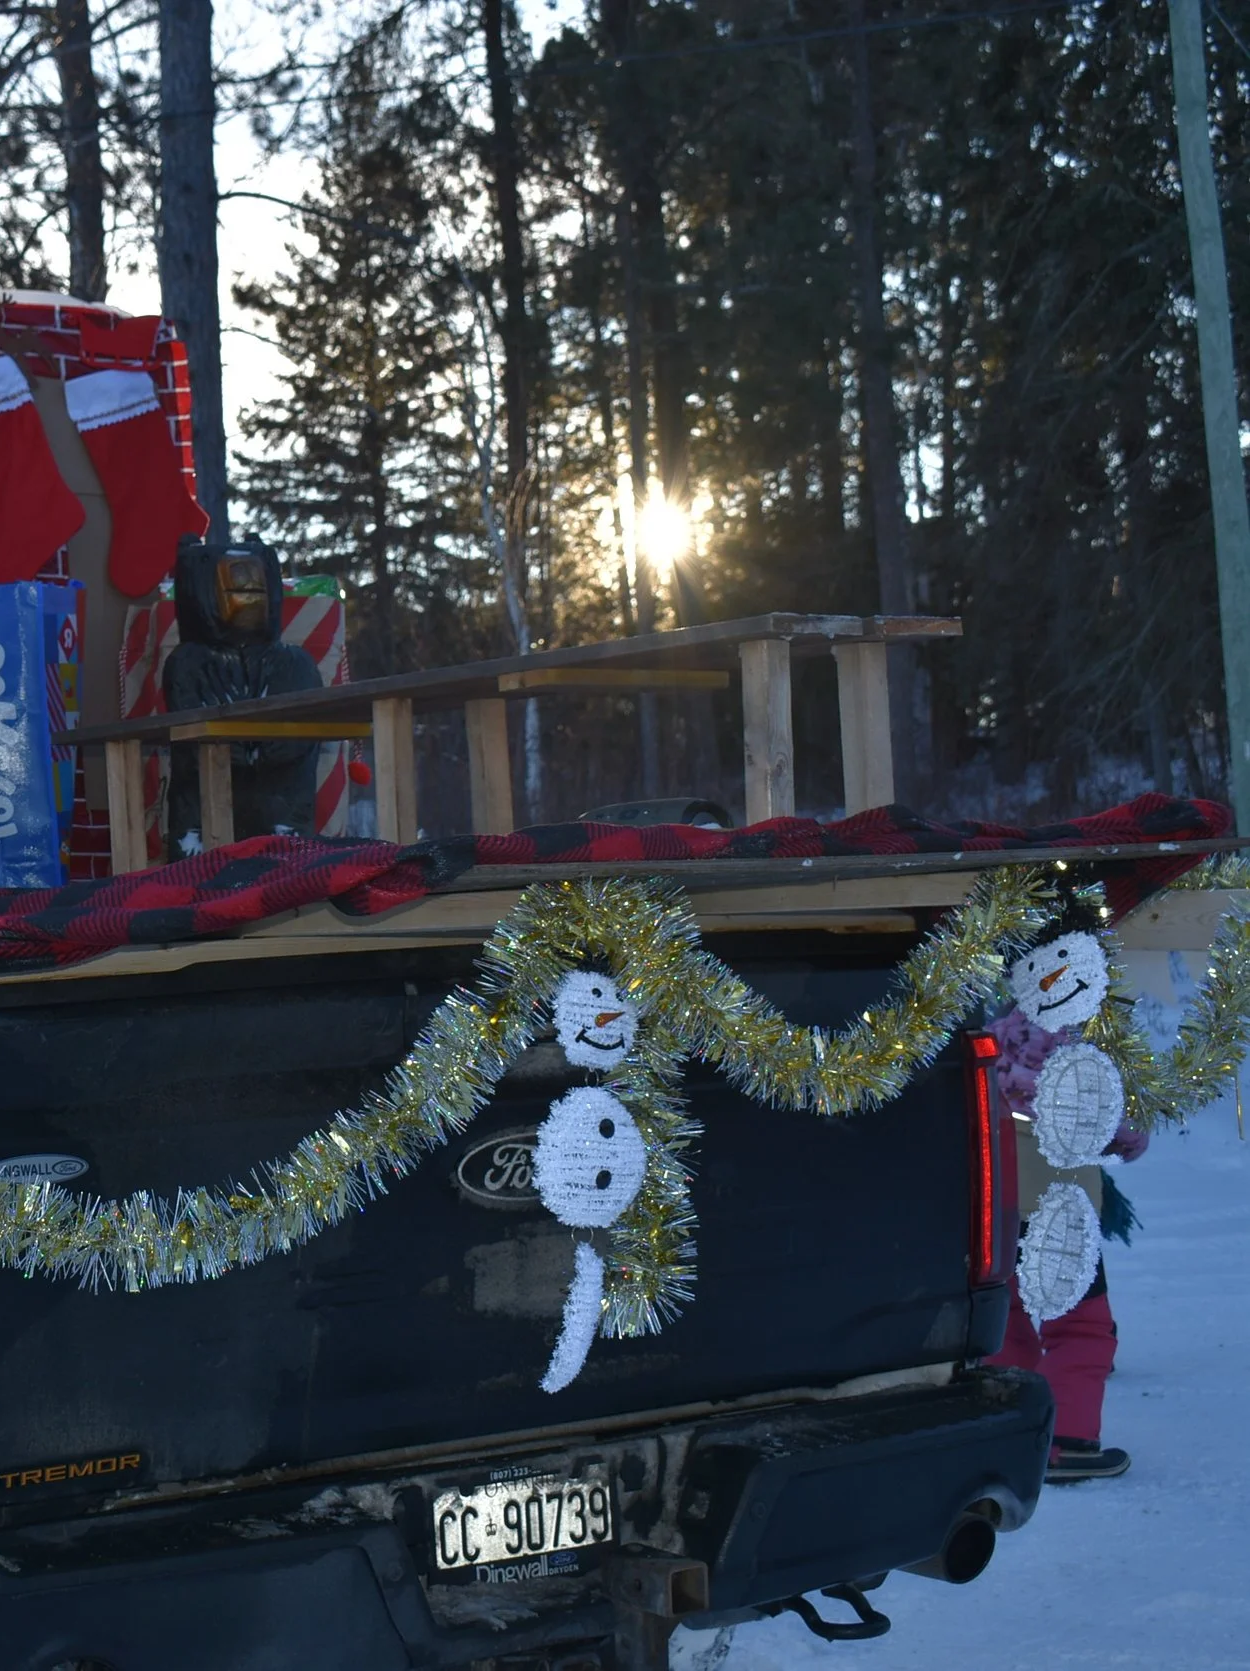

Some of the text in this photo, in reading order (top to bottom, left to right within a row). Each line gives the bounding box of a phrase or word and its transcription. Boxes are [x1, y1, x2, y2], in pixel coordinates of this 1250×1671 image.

[484, 1143, 536, 1191] Fo
[439, 1486, 610, 1566] CC 90739
[475, 1554, 548, 1584] Dingwall
